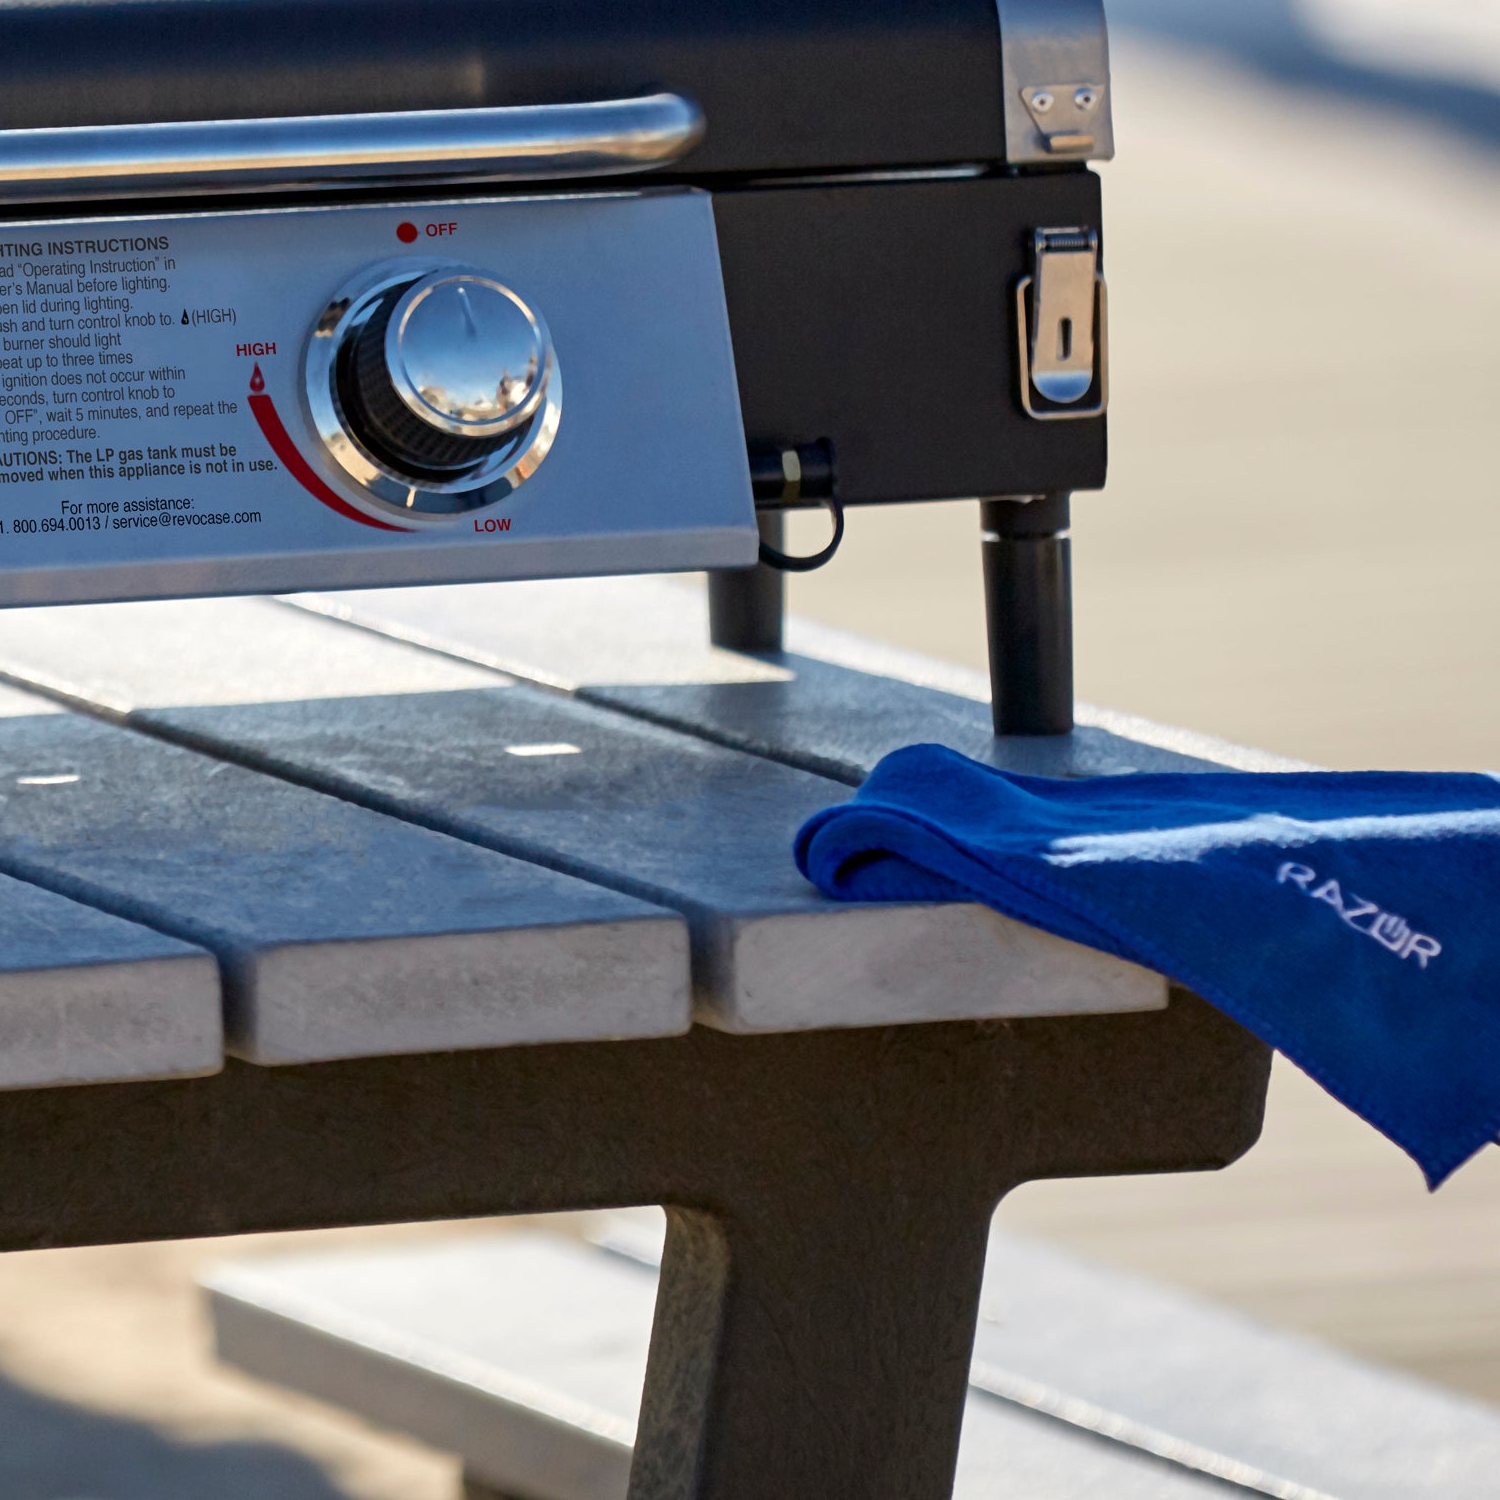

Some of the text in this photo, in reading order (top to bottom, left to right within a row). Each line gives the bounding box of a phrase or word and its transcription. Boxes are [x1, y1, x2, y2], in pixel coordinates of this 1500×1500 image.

[426, 223, 458, 237] OFF
[48, 236, 169, 255] INSTRUCTIONS
[164, 257, 175, 270] in
[26, 280, 72, 295] Manual
[77, 278, 117, 292] before
[122, 275, 170, 293] lighting.
[22, 301, 36, 314] lid
[41, 299, 80, 315] during
[84, 297, 133, 315] lighting.
[21, 317, 45, 332] and
[49, 317, 73, 330] turn
[77, 313, 120, 329] control
[125, 311, 154, 327] knob
[159, 312, 175, 326] to.
[191, 308, 236, 327] (HIGH)
[3, 336, 43, 351] burner
[49, 334, 90, 349] should
[94, 333, 121, 350] light
[236, 342, 276, 357] HIGH
[26, 356, 42, 371] up
[46, 354, 58, 367] to
[62, 352, 95, 366] three
[99, 351, 133, 365] times
[2, 373, 47, 391] ignition
[51, 370, 82, 385] does
[86, 369, 106, 383] not
[110, 370, 143, 382] occur
[148, 366, 185, 381] within
[52, 390, 78, 404] turn
[81, 387, 124, 402] control
[128, 385, 158, 400] knob
[163, 386, 175, 398] to
[46, 407, 72, 422] wait
[76, 407, 84, 420] 5
[88, 404, 141, 421] minutes,
[146, 403, 169, 418] and
[174, 402, 214, 419] repeat
[218, 400, 237, 414] the
[33, 427, 99, 445] procedure.
[66, 449, 92, 464] The
[96, 449, 115, 462] LP
[119, 449, 143, 465] gas
[147, 446, 177, 460] tank
[181, 445, 216, 458] must
[220, 443, 236, 457] be
[48, 467, 85, 481] when
[89, 465, 114, 479] this
[119, 462, 186, 480] appliance
[190, 461, 201, 474] is
[206, 459, 227, 473] not
[232, 458, 245, 471] in
[249, 458, 277, 471] use.
[61, 496, 194, 515] For more assistance:
[13, 516, 100, 533] 800.694.0013
[112, 512, 261, 530] service@revocase.com
[474, 519, 511, 532] LOW
[1276, 862, 1442, 969] RAZOR
